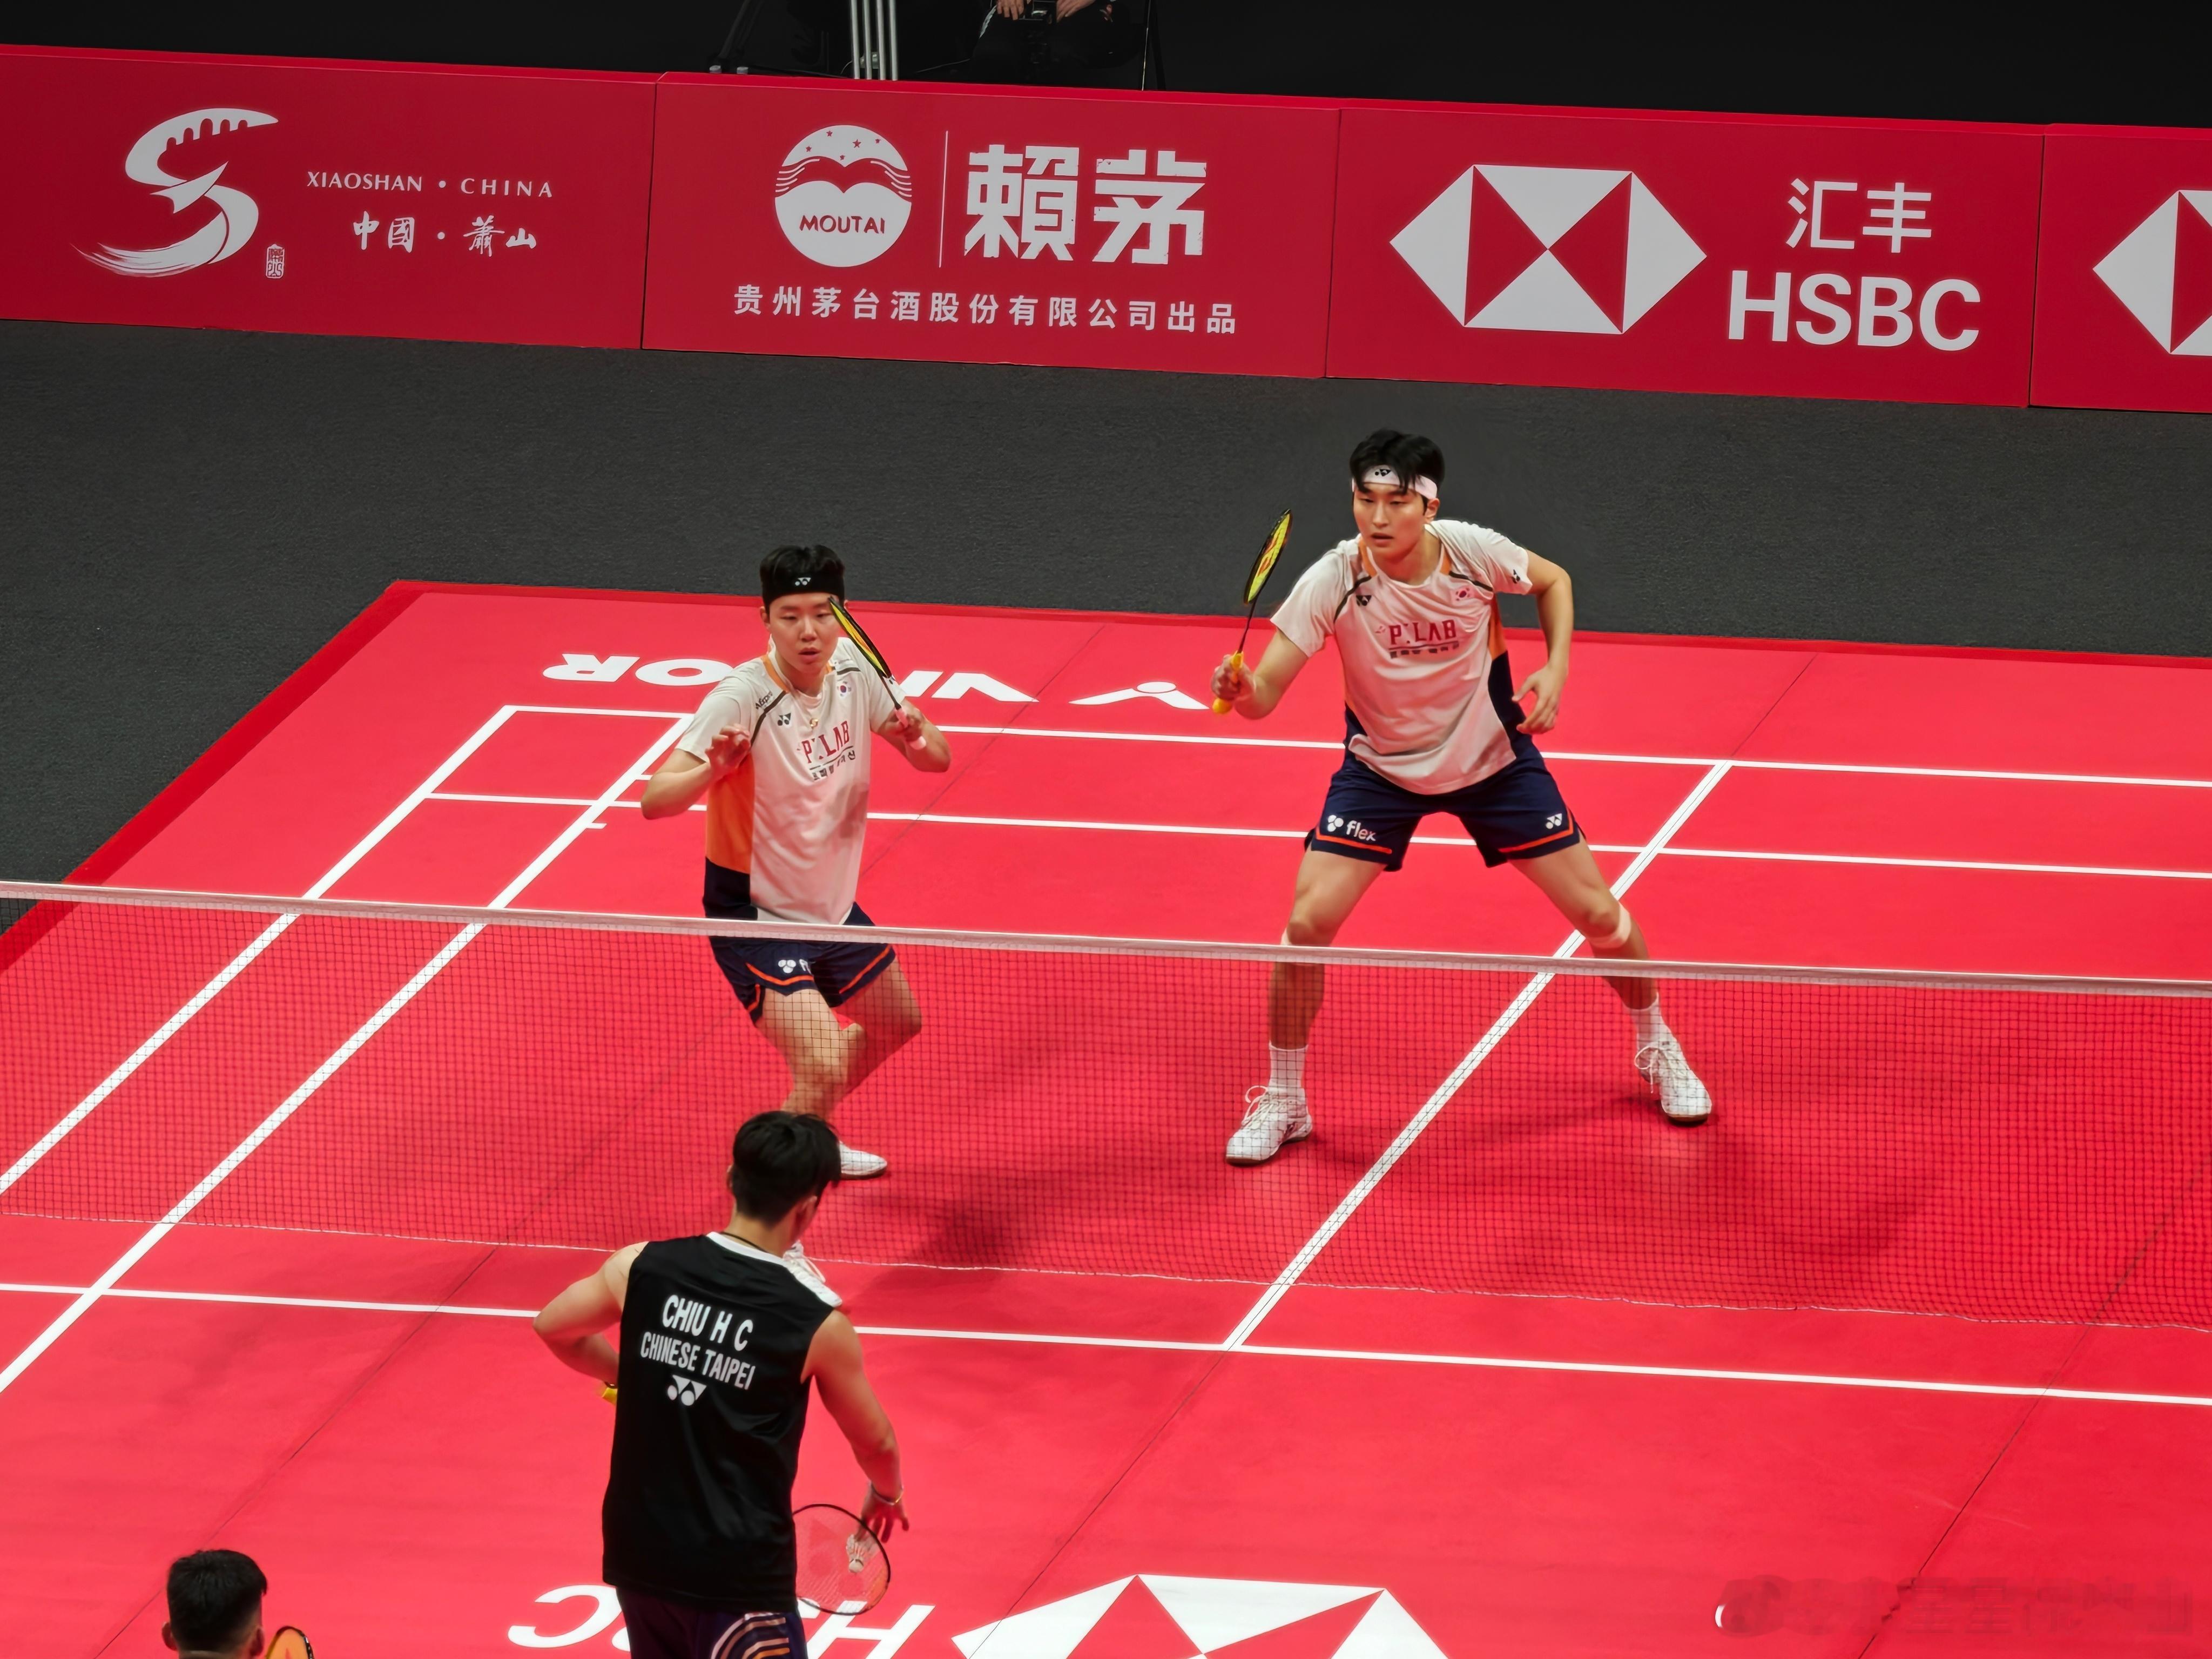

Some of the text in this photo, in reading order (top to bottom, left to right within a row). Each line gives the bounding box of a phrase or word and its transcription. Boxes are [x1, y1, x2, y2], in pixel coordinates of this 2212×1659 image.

[307, 171, 422, 192] XIAOSHAN
[461, 178, 552, 198] CHINA
[799, 215, 885, 234] MOUTAI
[1785, 178, 1932, 253] 汇丰
[734, 284, 1236, 334] 贵州茅台酒股份有限公司出品
[1728, 270, 1980, 351] HSBC
[1346, 820, 1376, 841] flex
[662, 1294, 753, 1351] CHIU H C
[640, 1332, 756, 1390] CHINESE TAIPEI
